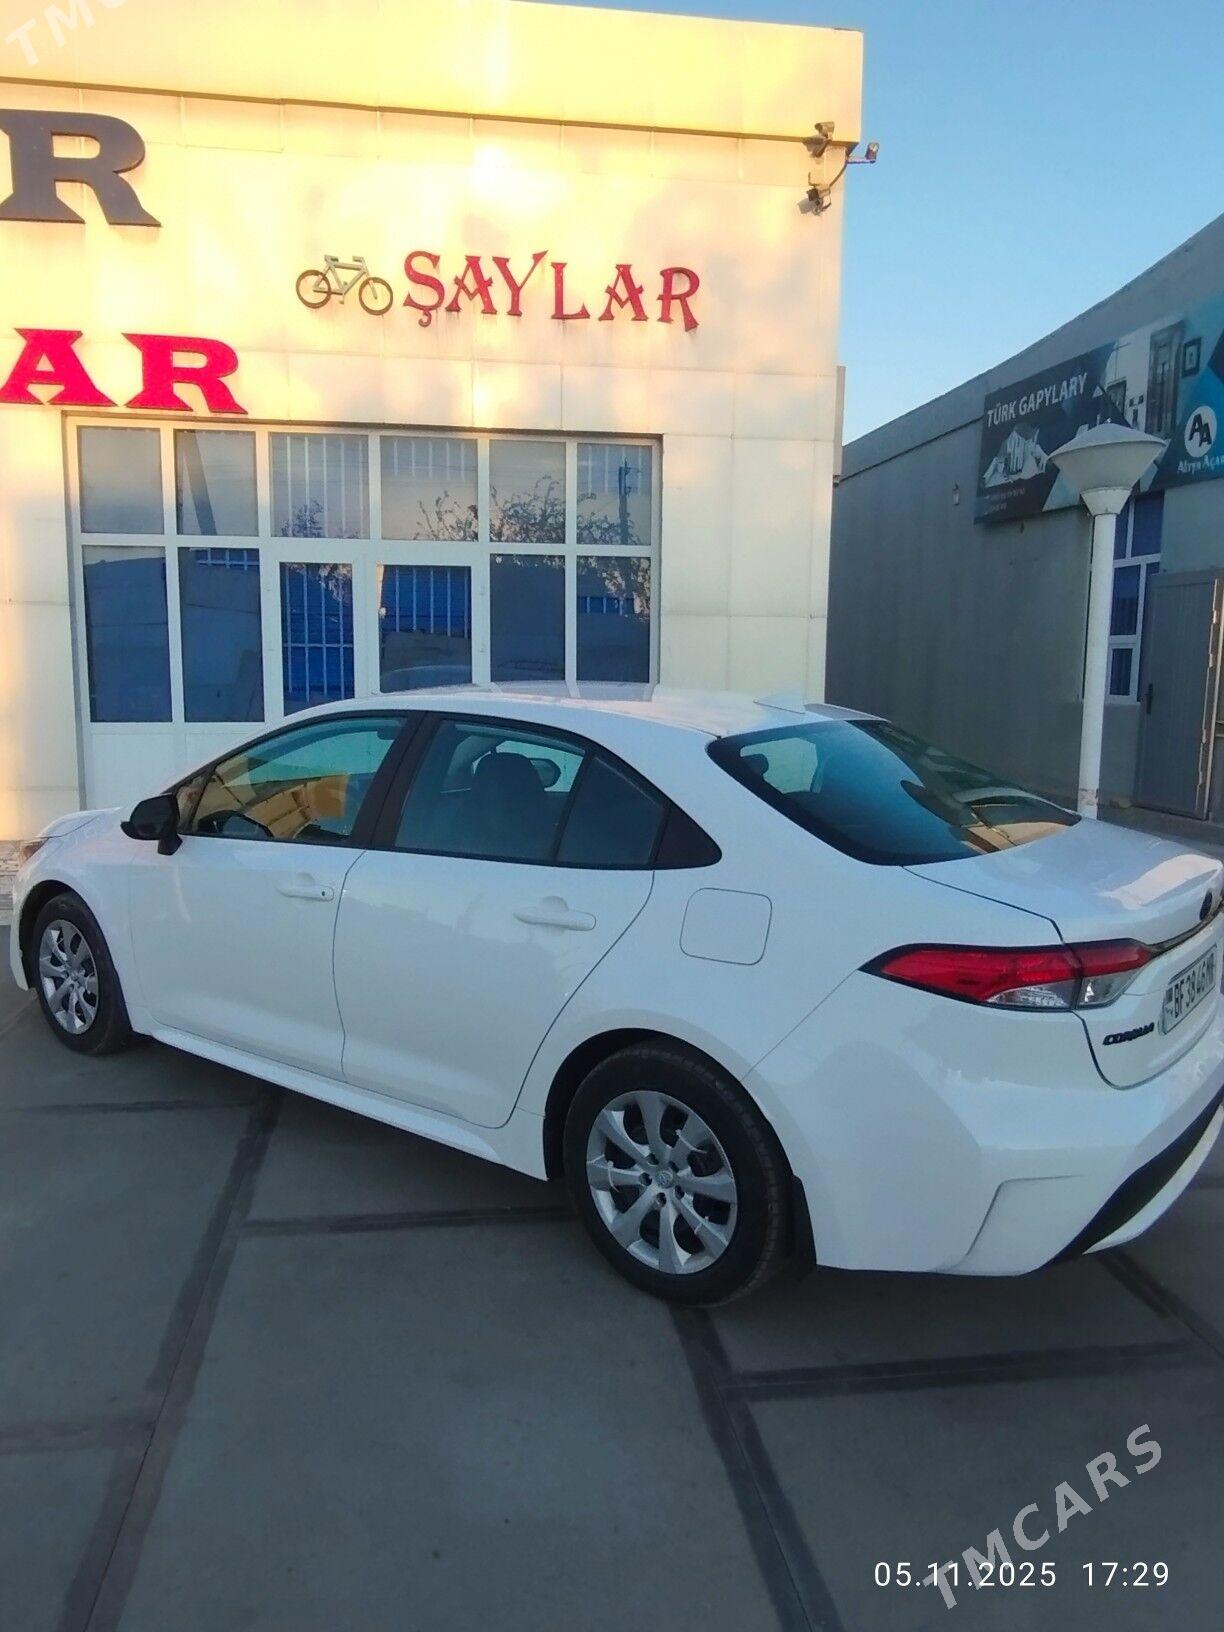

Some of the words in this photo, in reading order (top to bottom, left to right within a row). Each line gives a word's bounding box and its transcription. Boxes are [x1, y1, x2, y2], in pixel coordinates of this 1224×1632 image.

[0, 110, 161, 227] R
[404, 250, 701, 332] ŞAYLAR
[986, 402, 1017, 428] TÜRK
[1018, 371, 1088, 416] GAPYLARY
